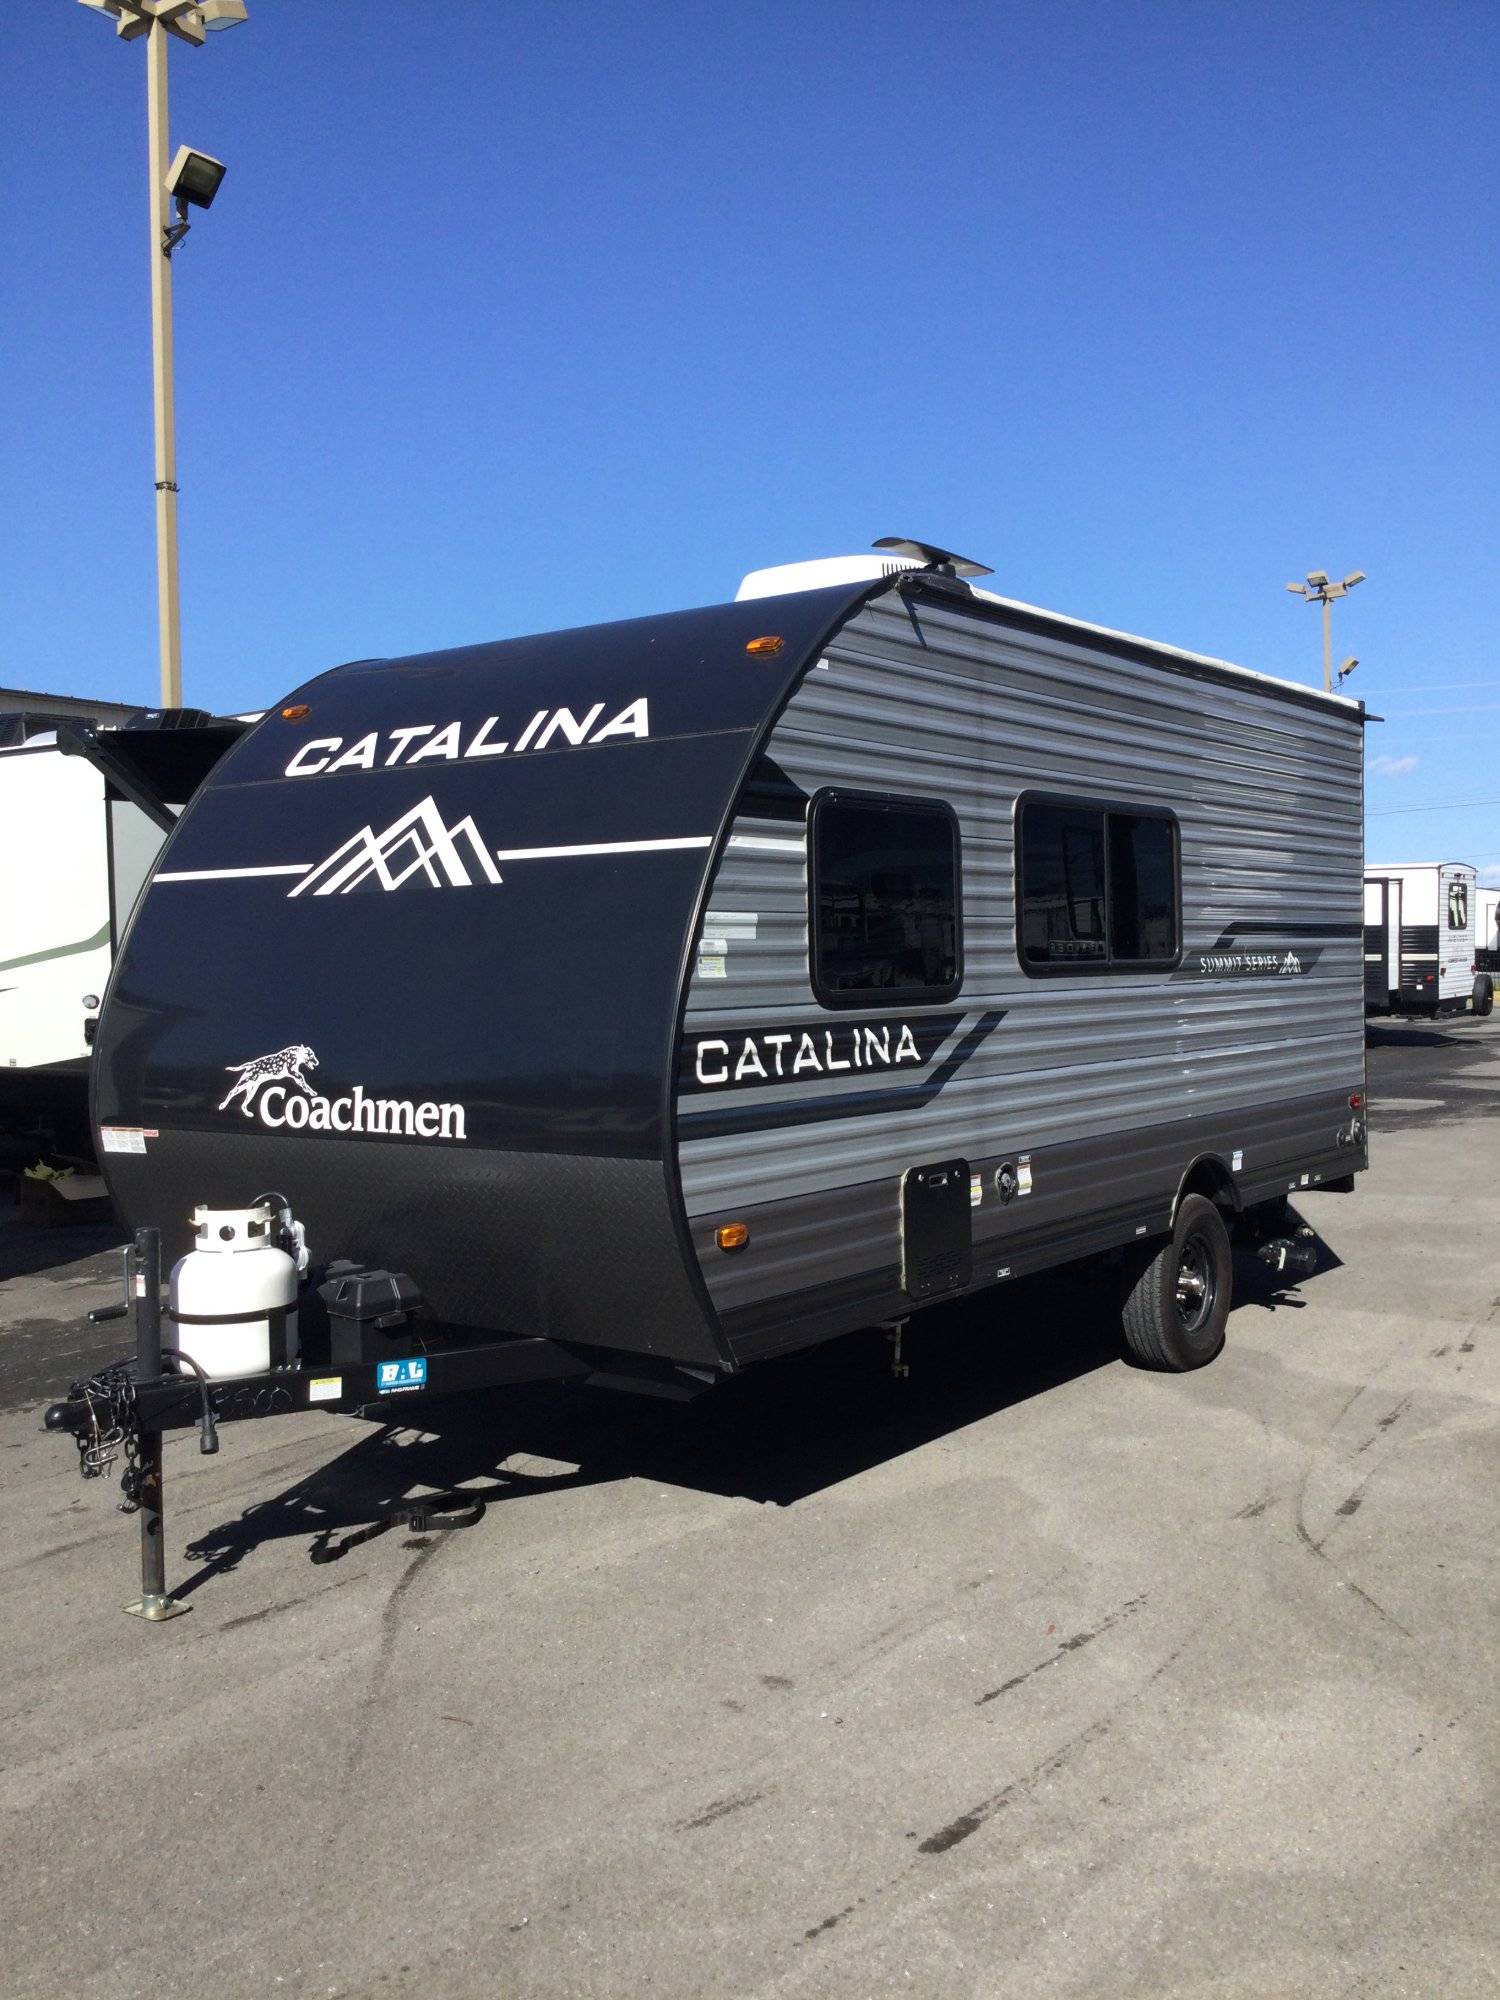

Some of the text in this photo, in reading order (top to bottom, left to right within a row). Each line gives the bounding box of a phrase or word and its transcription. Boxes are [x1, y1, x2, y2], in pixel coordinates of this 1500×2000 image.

[284, 697, 649, 777] CATALINA
[1200, 955, 1279, 973] SUMMIT SERIES
[696, 1024, 921, 1084] CATALINA
[259, 1085, 467, 1140] Coachmen
